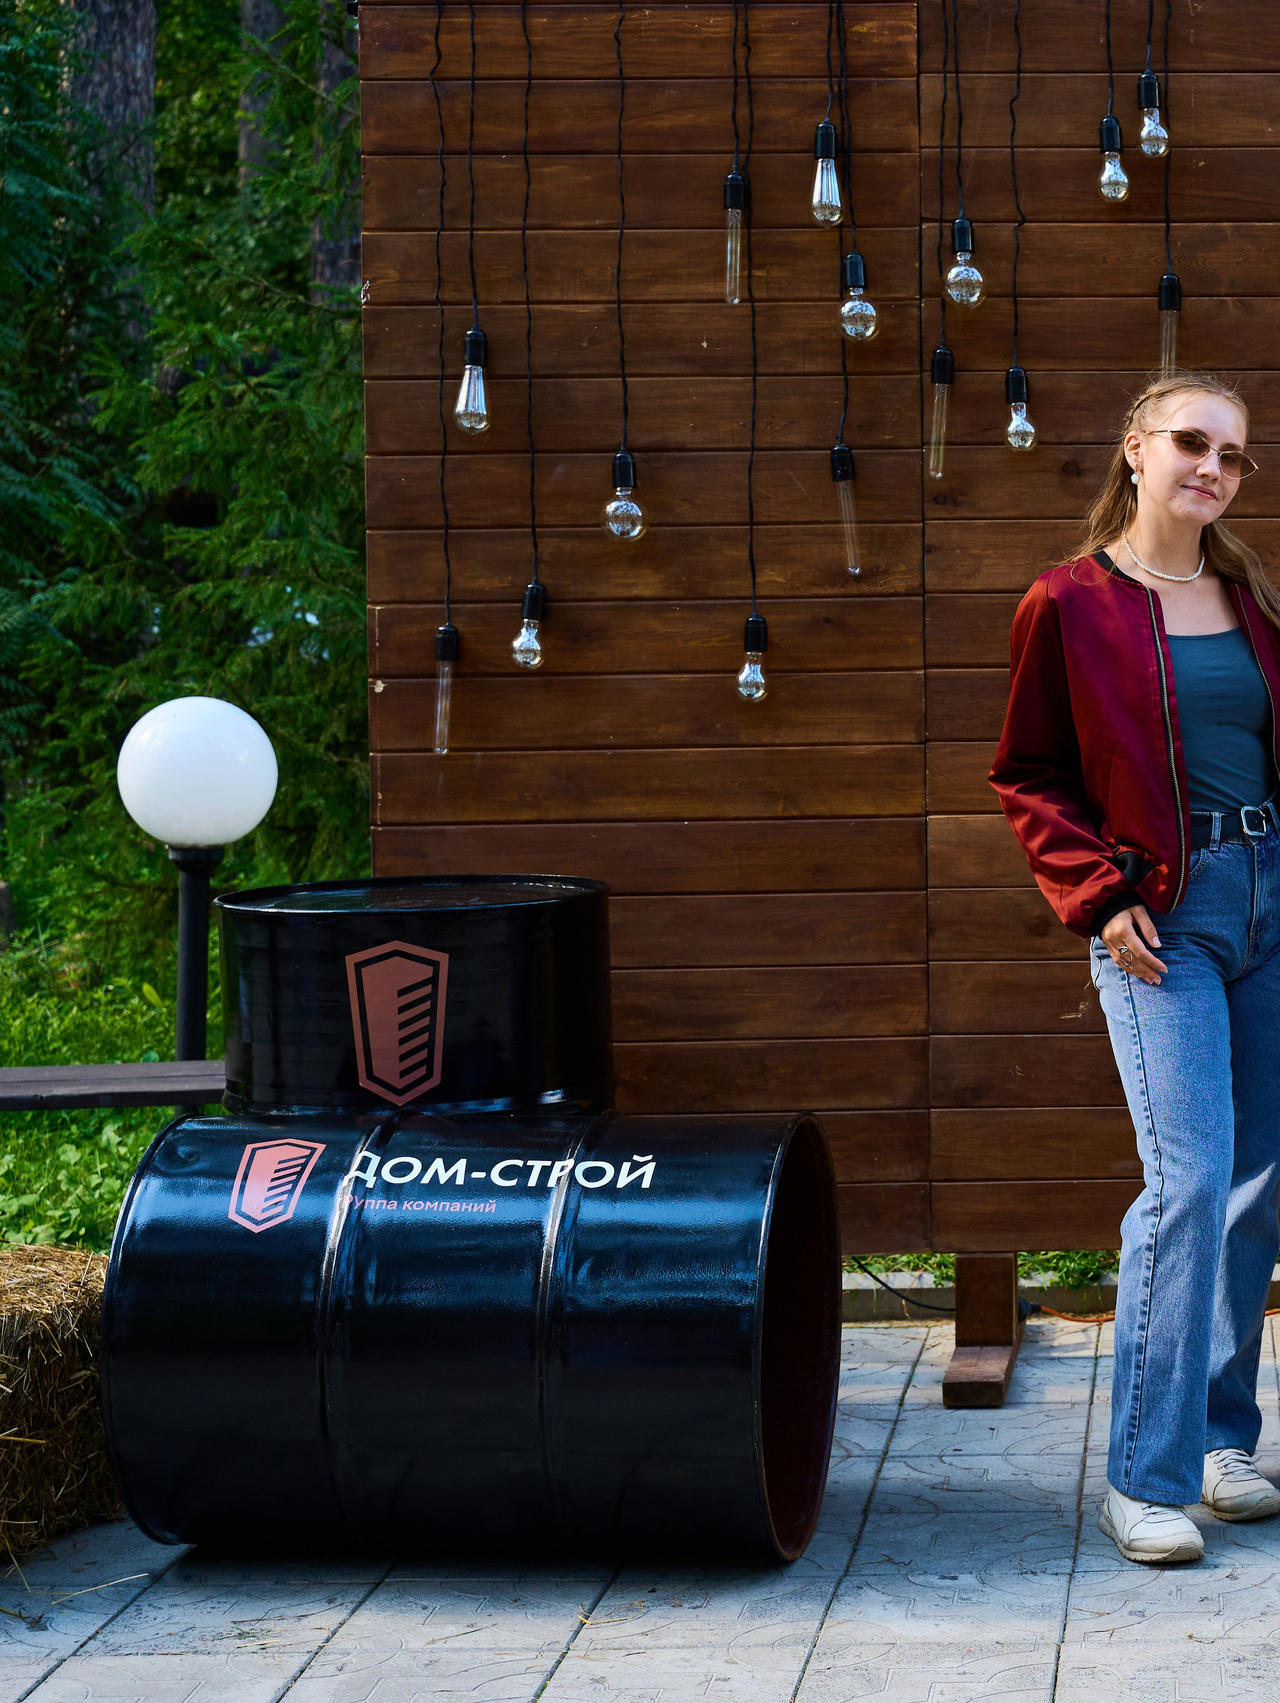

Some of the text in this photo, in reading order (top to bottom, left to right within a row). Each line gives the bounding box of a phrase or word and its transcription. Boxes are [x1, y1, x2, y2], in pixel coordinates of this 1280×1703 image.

[342, 1150, 657, 1189] ДОМ-СТРОЙ
[339, 1194, 497, 1214] руппа компаний
